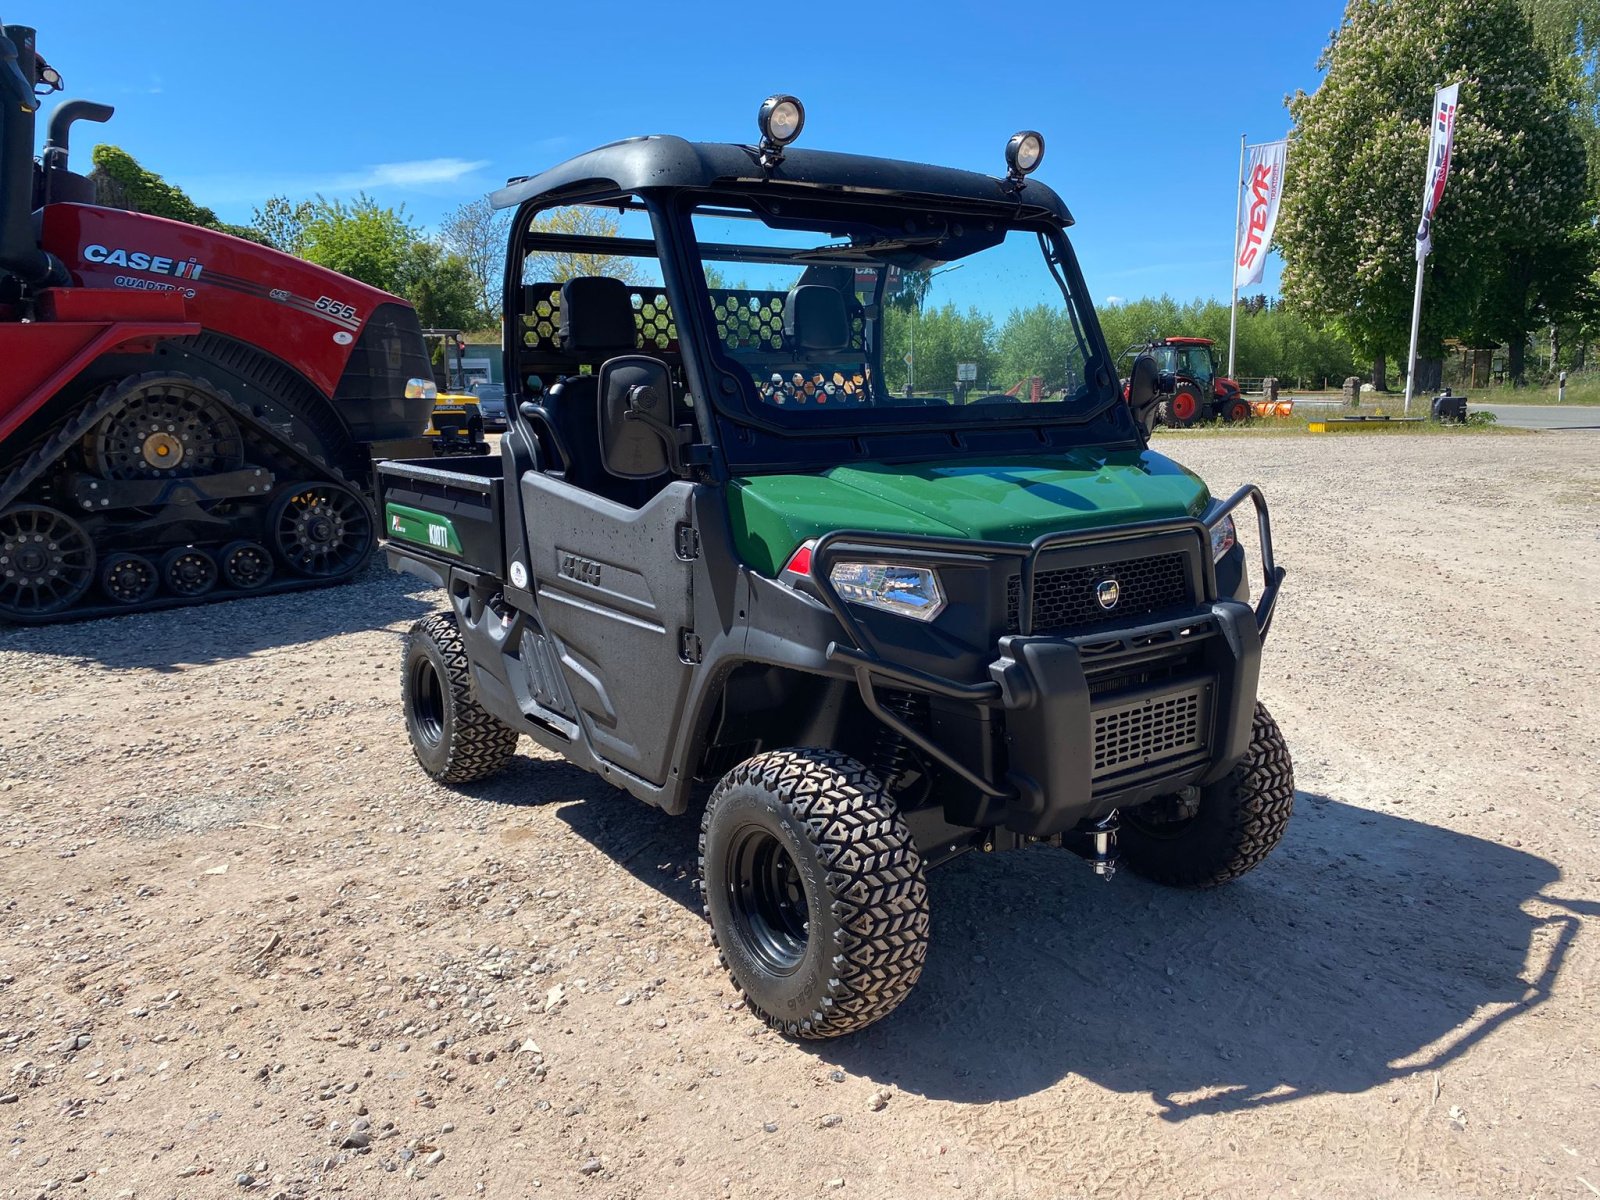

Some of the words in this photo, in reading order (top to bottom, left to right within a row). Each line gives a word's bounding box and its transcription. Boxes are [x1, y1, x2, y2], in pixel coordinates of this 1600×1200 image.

[1239, 163, 1272, 269] STEYR
[83, 244, 173, 274] CASE
[315, 296, 356, 320] 555
[428, 523, 448, 549] KIOTI
